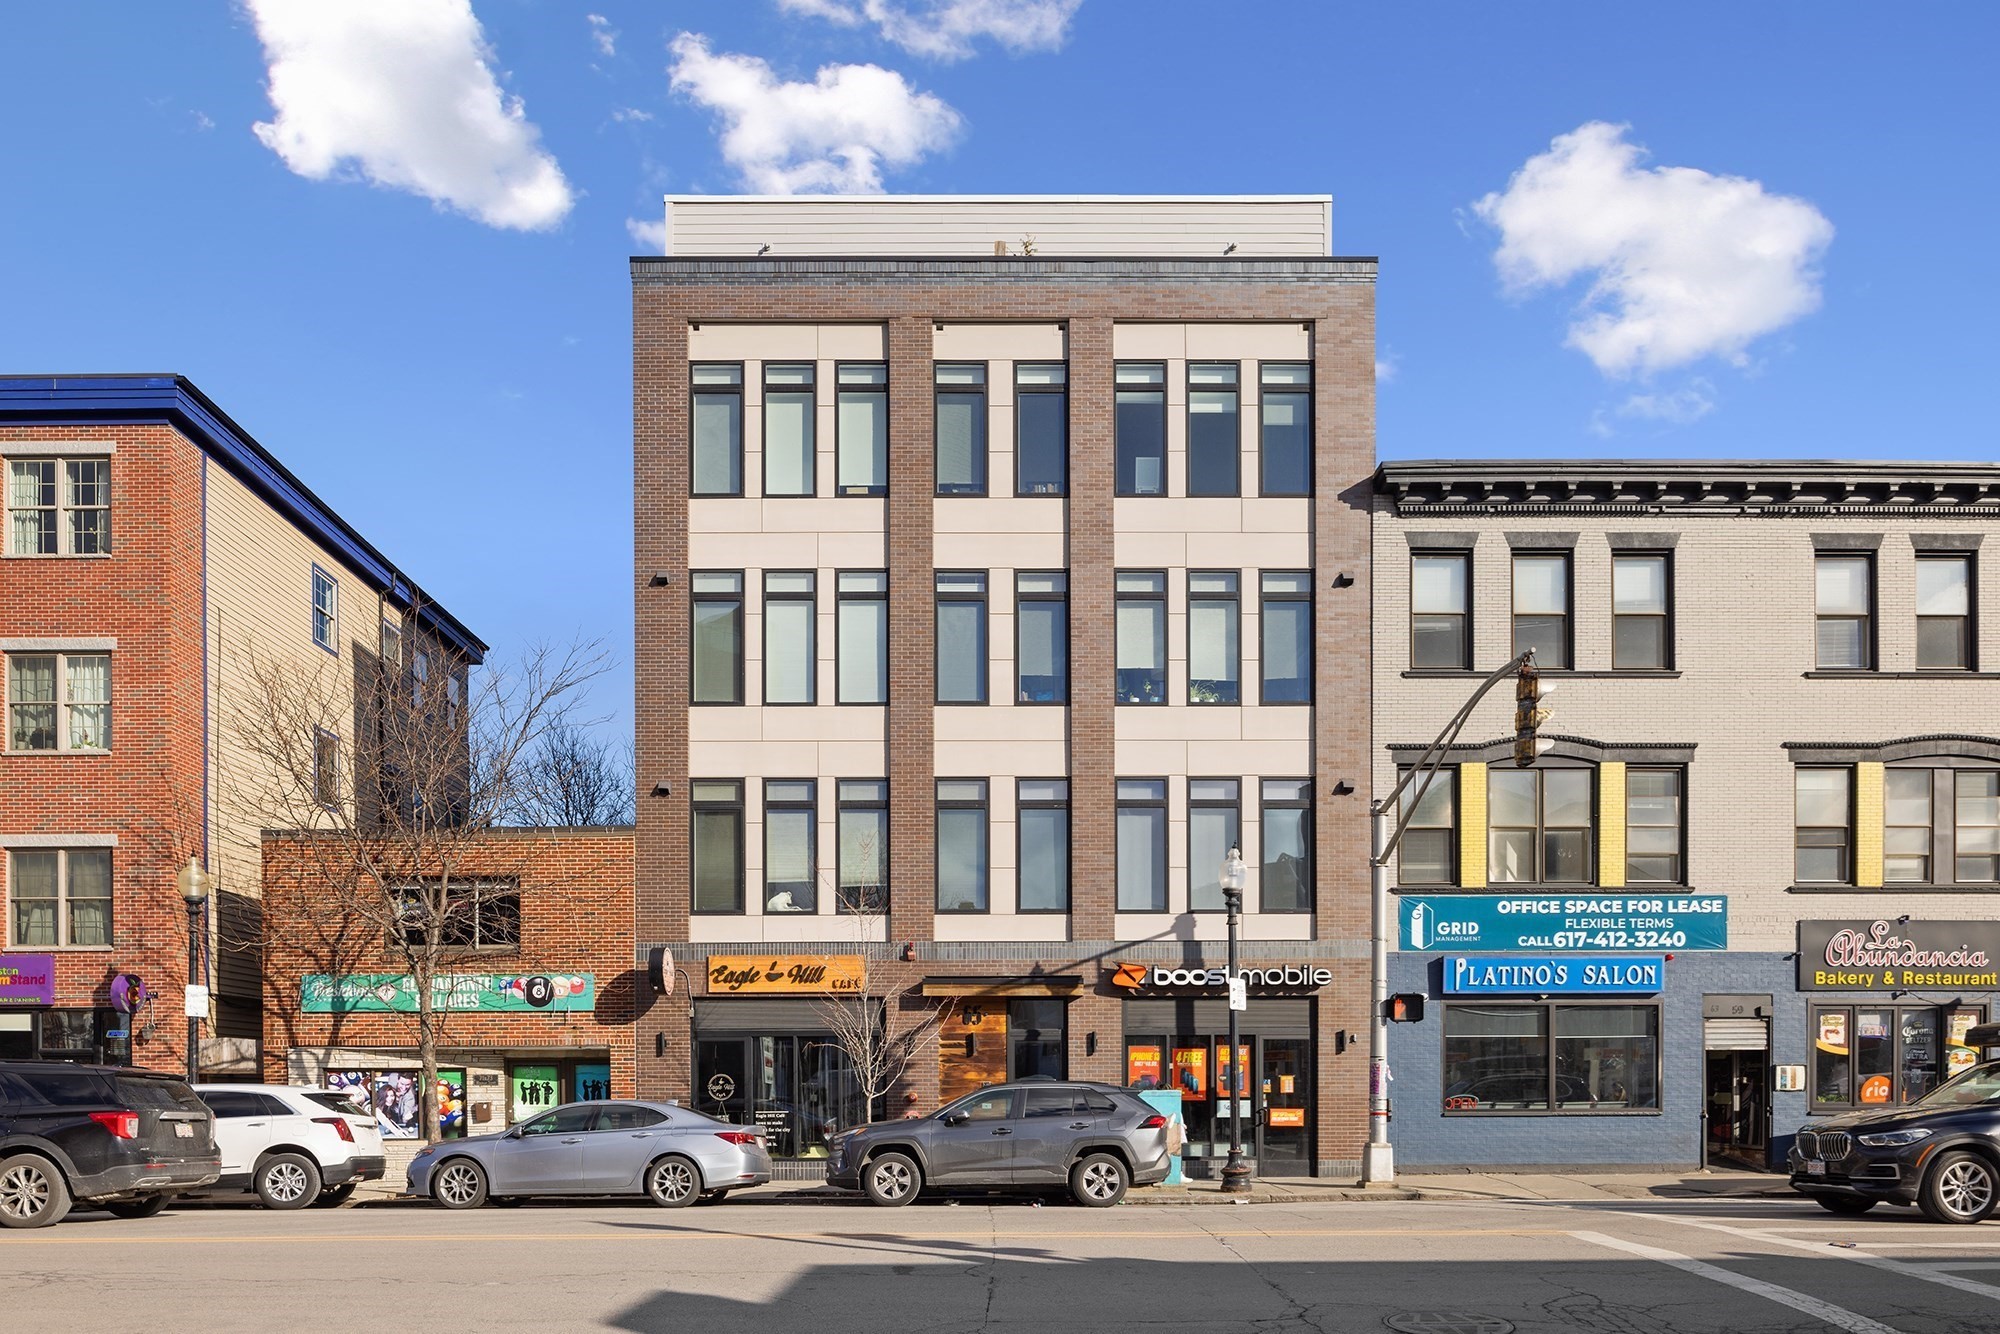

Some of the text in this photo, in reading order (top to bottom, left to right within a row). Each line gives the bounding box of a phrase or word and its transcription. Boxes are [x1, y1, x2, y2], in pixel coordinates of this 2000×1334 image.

[1497, 900, 1723, 914] OFFICE SPACE FOR LEASE
[1436, 921, 1480, 935] GRID
[1565, 918, 1674, 929] FLEXIBLE TERMS
[1517, 931, 1686, 948] CALL 617-412-3240
[1865, 920, 1902, 950] La
[1824, 928, 1990, 968] Abundancia
[709, 964, 827, 991] Eagle Hill
[1583, 964, 1657, 985] SALON
[1815, 971, 1998, 987] Bakery & Restaurant
[535, 987, 543, 996] 8
[415, 993, 480, 1008] BLLARES
[1901, 1025, 1934, 1038] Corona
[1176, 1051, 1204, 1063] 4 FREE
[1445, 1097, 1477, 1110] OPEN
